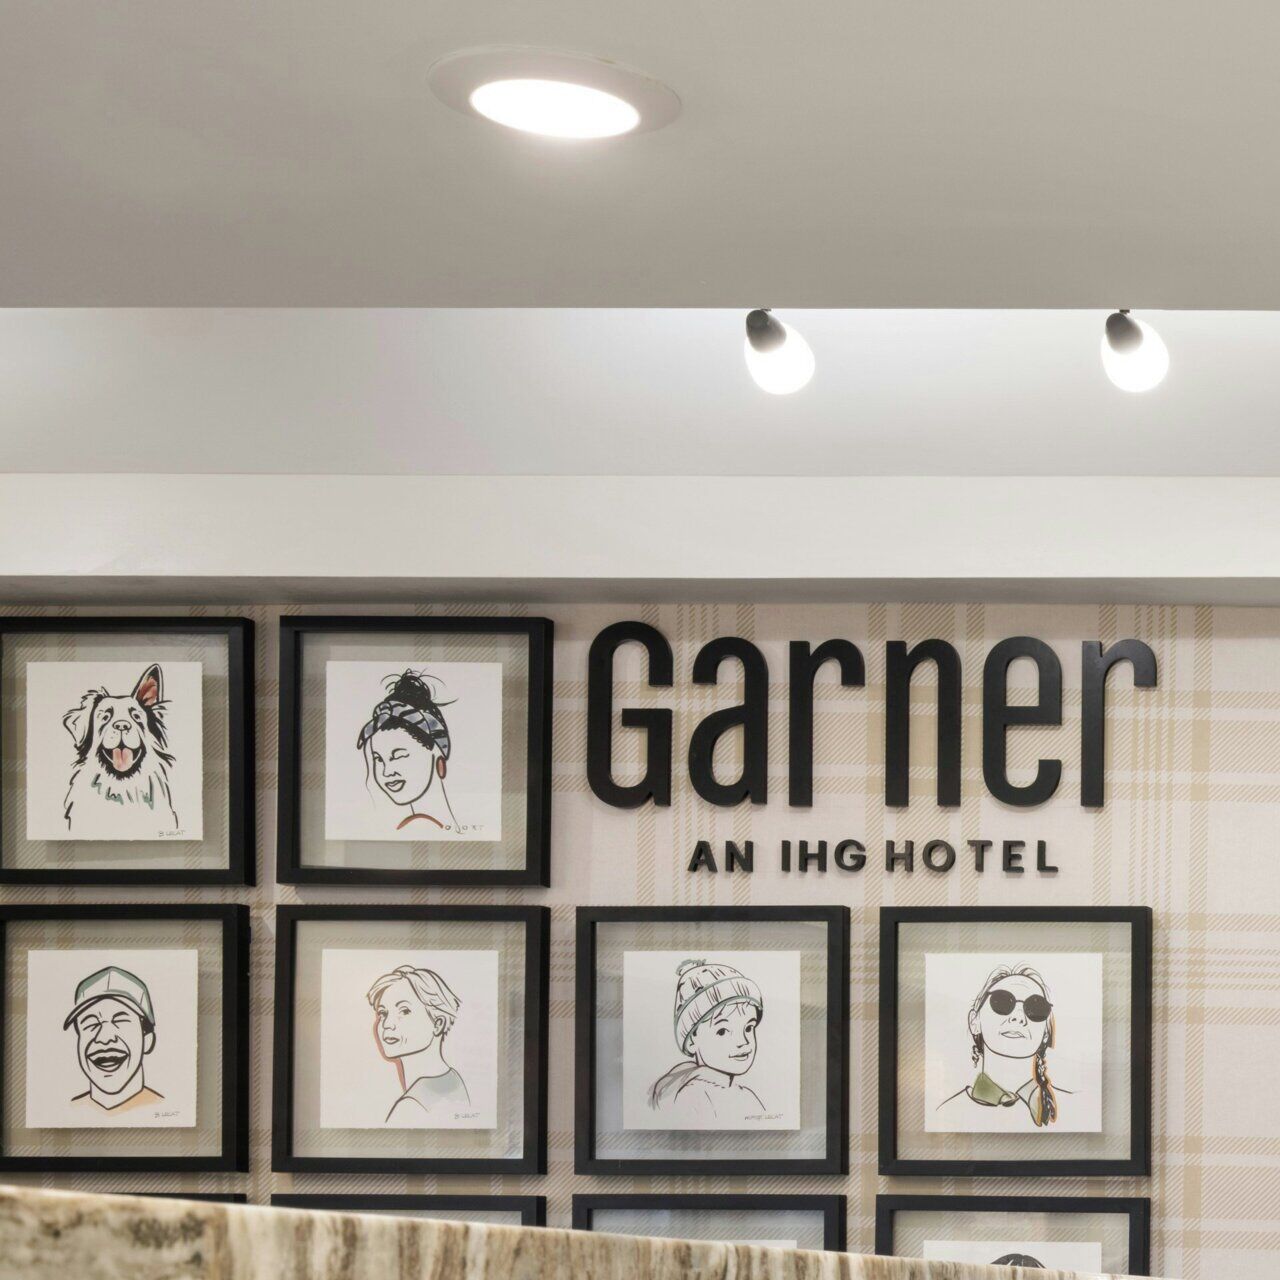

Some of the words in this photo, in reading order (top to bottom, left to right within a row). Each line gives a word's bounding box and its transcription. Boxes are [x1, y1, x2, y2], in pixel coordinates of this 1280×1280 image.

[586, 620, 1158, 808] Garner
[687, 840, 754, 873] AN
[781, 840, 867, 873] IHG
[885, 840, 1059, 873] HOTEL
